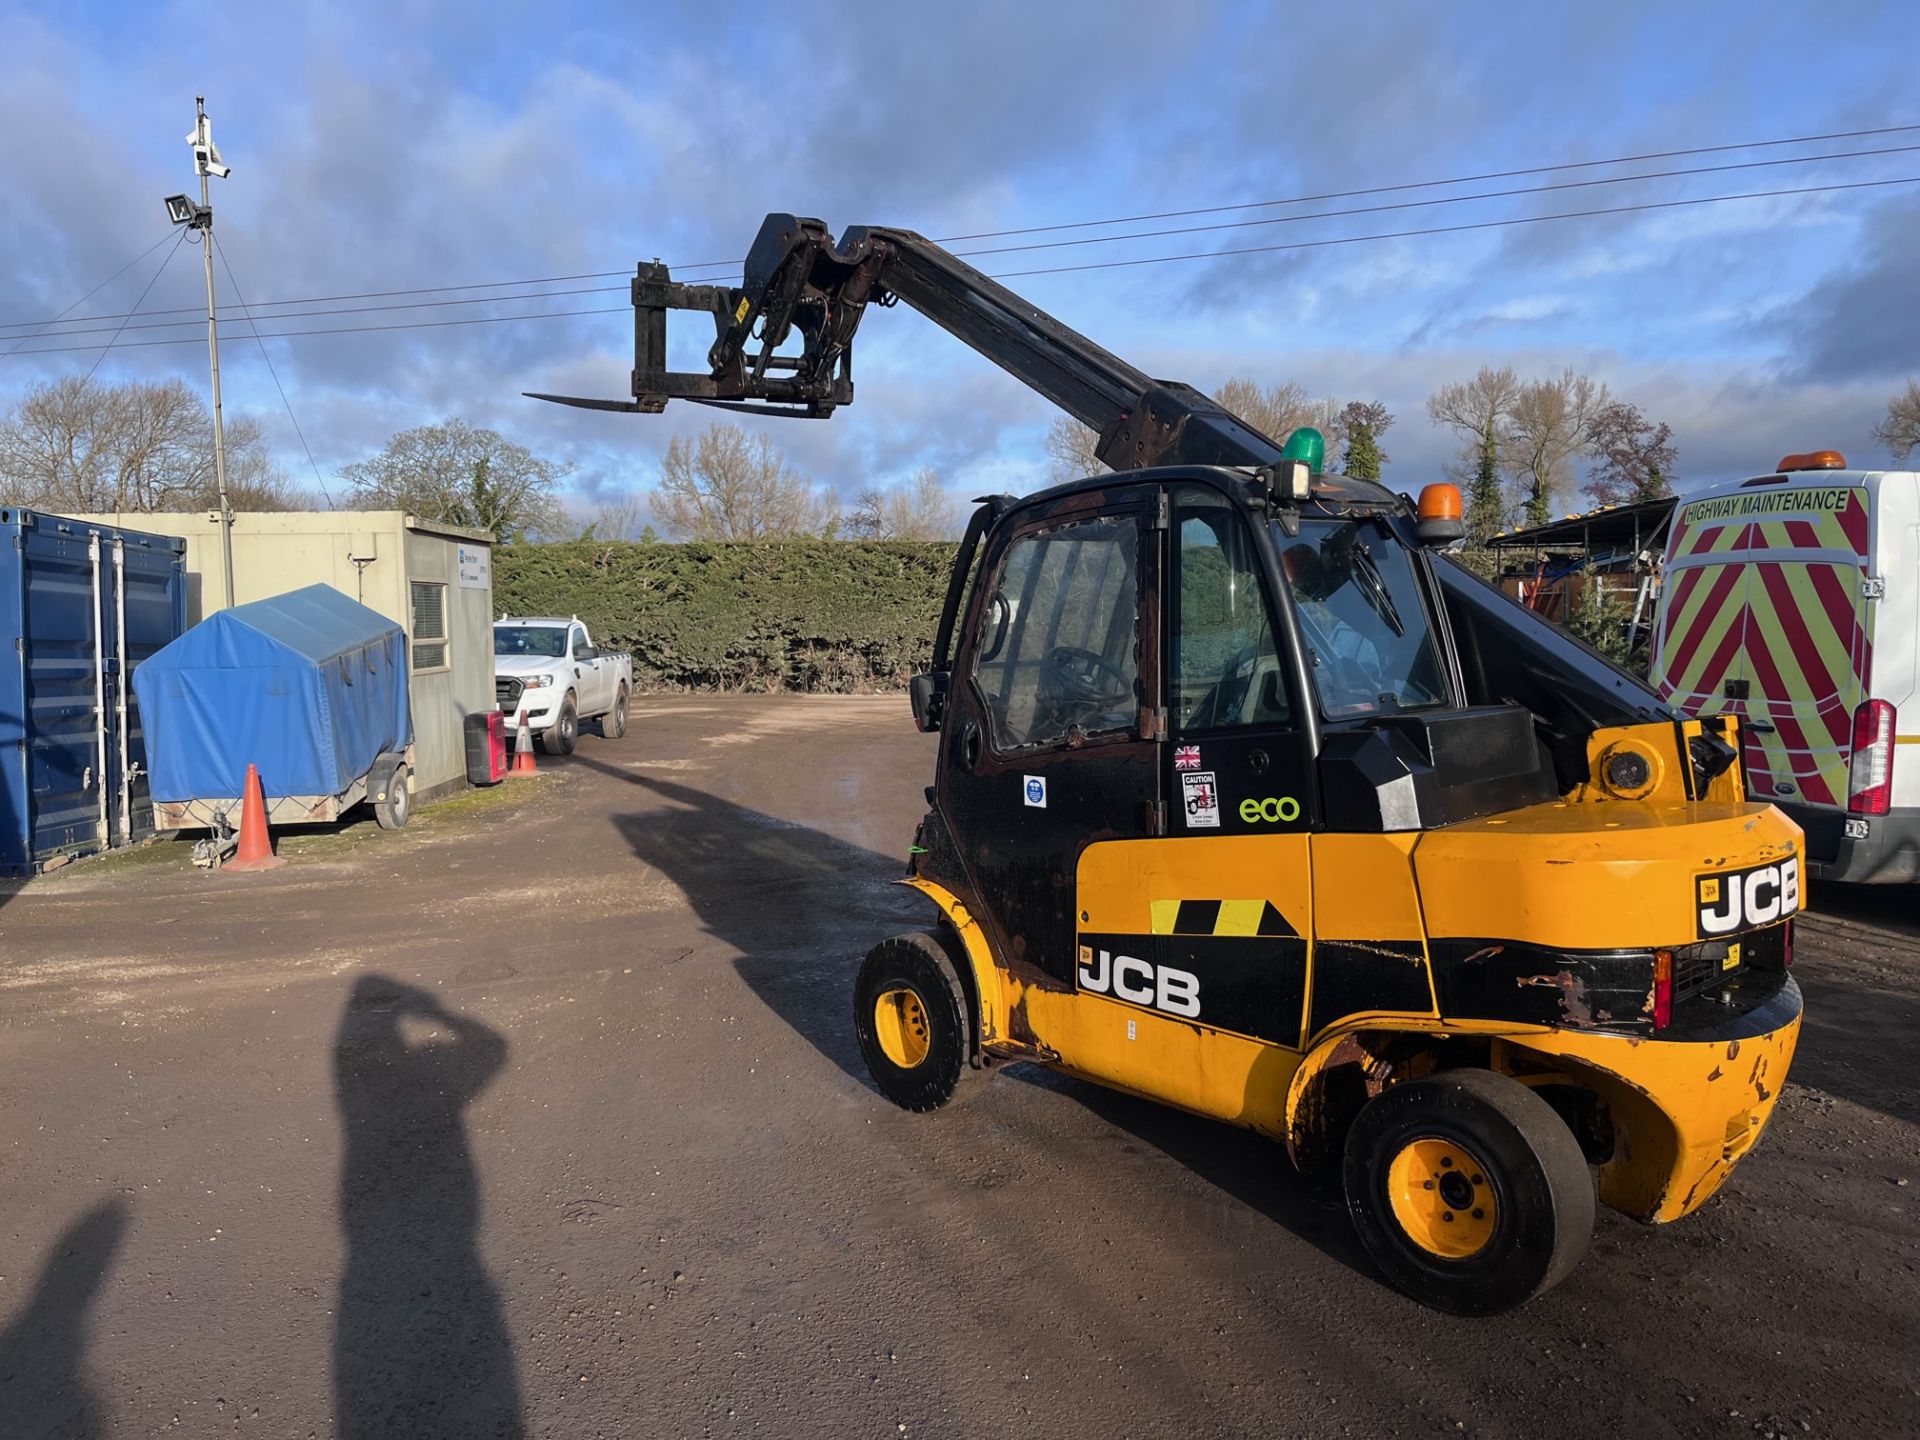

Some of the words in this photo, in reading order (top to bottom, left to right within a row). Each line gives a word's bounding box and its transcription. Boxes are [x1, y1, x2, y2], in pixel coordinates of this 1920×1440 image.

[1686, 498, 1740, 521] HIGHWAY
[1740, 490, 1848, 515] MAINTENANCE
[1185, 775, 1213, 784] CAUTION
[1239, 796, 1300, 823] eco
[1700, 858, 1799, 933] JCB
[1079, 949, 1201, 1018] JCB
